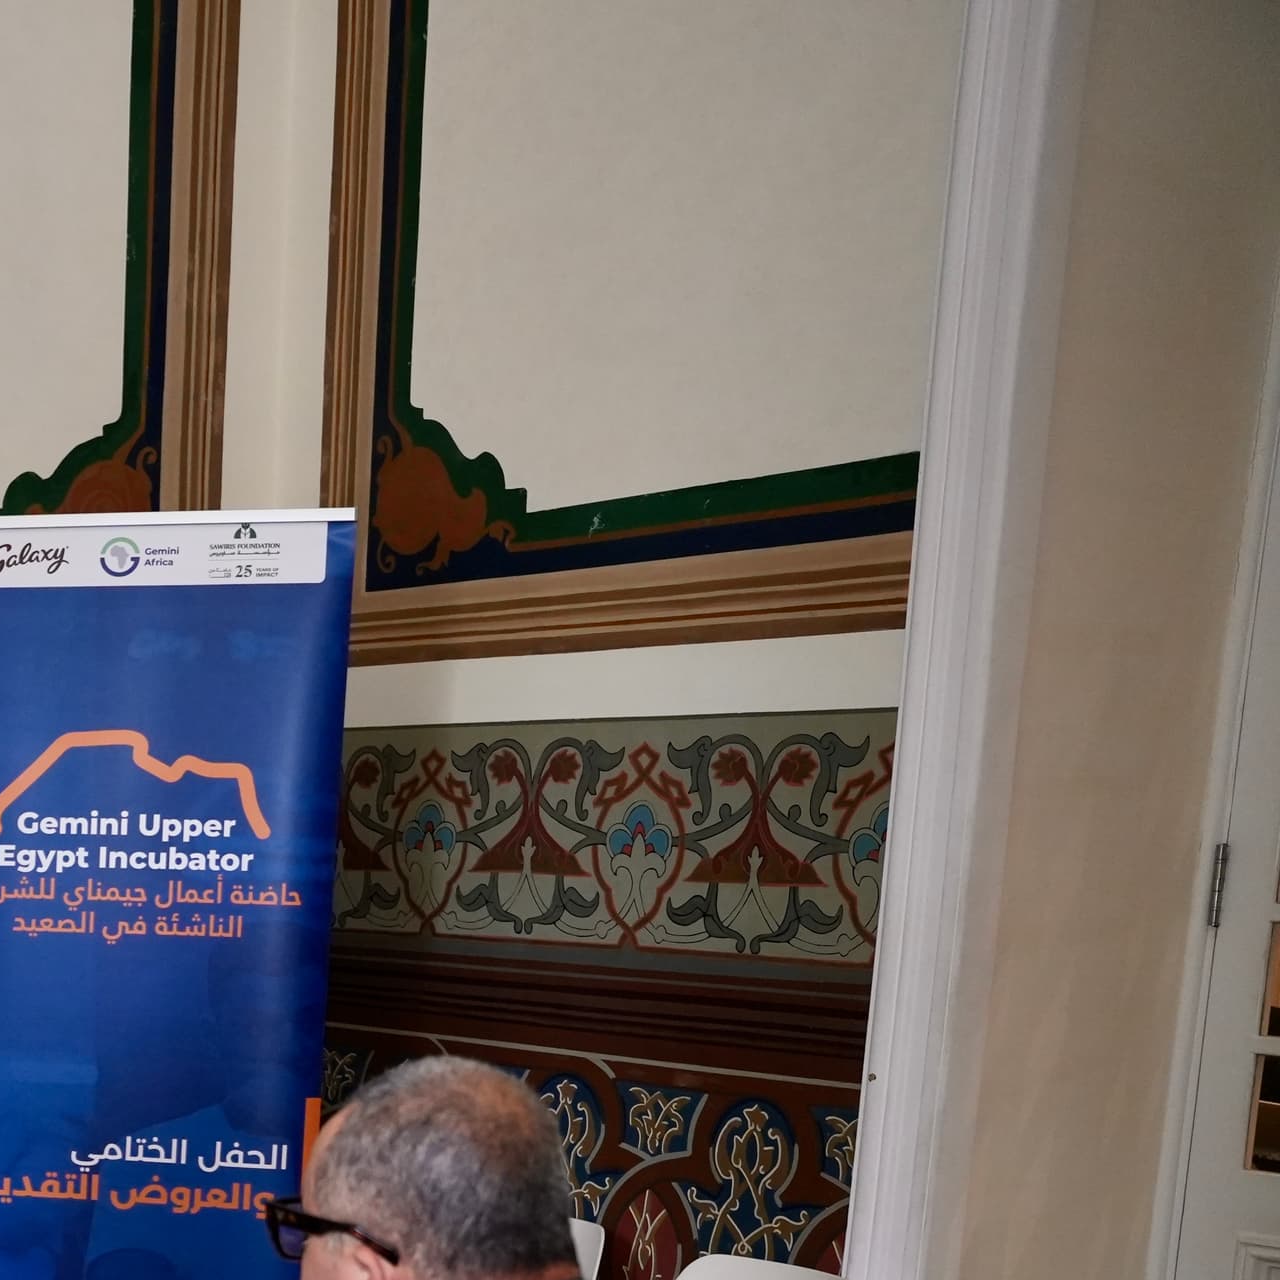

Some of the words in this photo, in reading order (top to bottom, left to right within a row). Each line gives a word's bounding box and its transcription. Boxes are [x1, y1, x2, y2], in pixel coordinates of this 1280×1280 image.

[144, 546, 180, 556] Gemini
[144, 558, 174, 567] Africa
[235, 564, 253, 578] 25
[17, 810, 129, 836] Gemini
[139, 813, 236, 842] Upper
[98, 846, 254, 872] Incubator
[63, 878, 147, 911] جيمناي
[154, 873, 223, 909] أعمال
[229, 883, 302, 907] حاضنة
[12, 911, 95, 937] الصعيد
[102, 915, 147, 944] في
[154, 913, 243, 938] الناشئة
[70, 1135, 188, 1173] الختامي
[197, 1140, 288, 1173] الحفل
